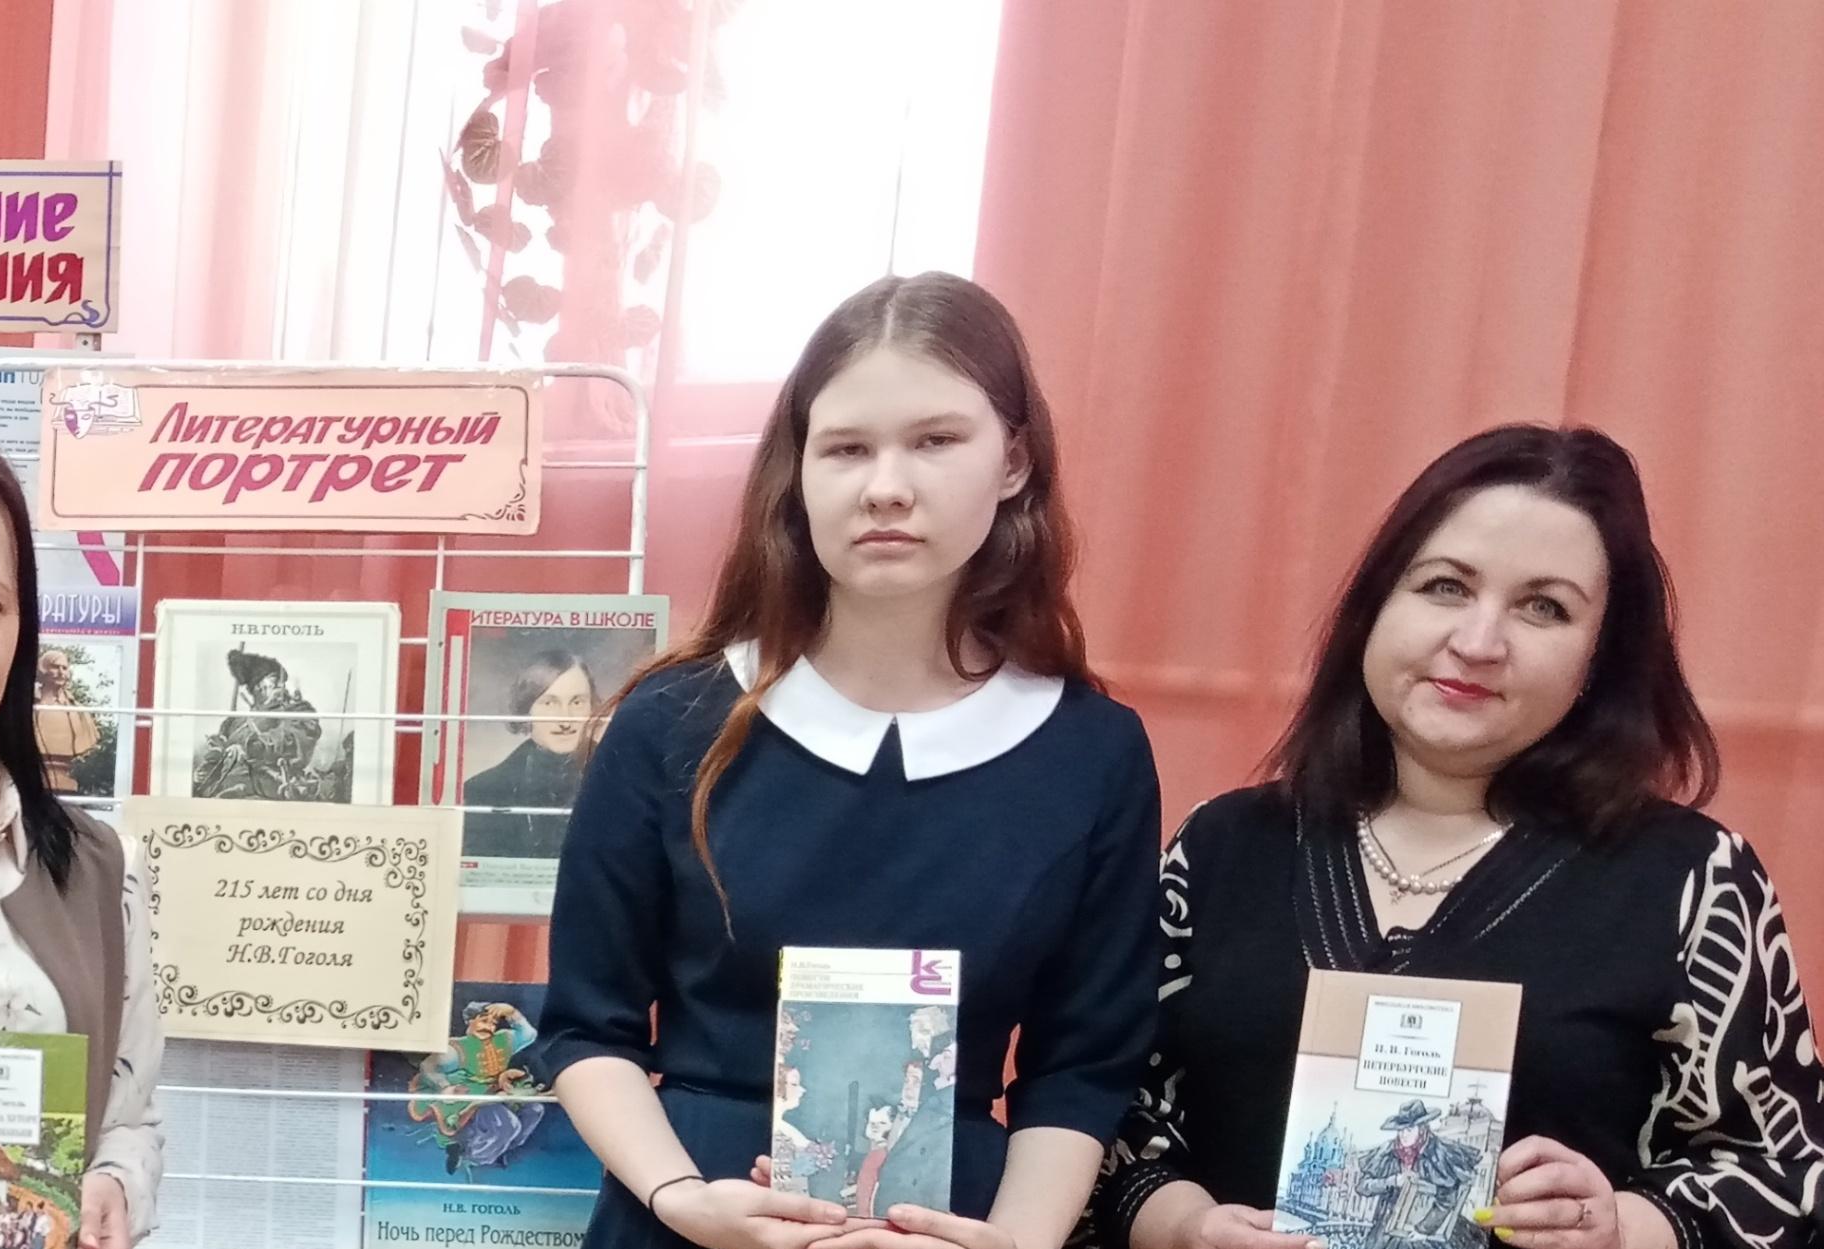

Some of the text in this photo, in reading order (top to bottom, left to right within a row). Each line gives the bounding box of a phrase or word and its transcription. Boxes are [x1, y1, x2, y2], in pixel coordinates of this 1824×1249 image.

[38, 593, 121, 624] РАТУРЫ
[570, 612, 580, 626] В
[585, 612, 655, 627] ШКОЛЕ
[214, 879, 373, 903] 215 лет со дня
[237, 911, 345, 937] рождения
